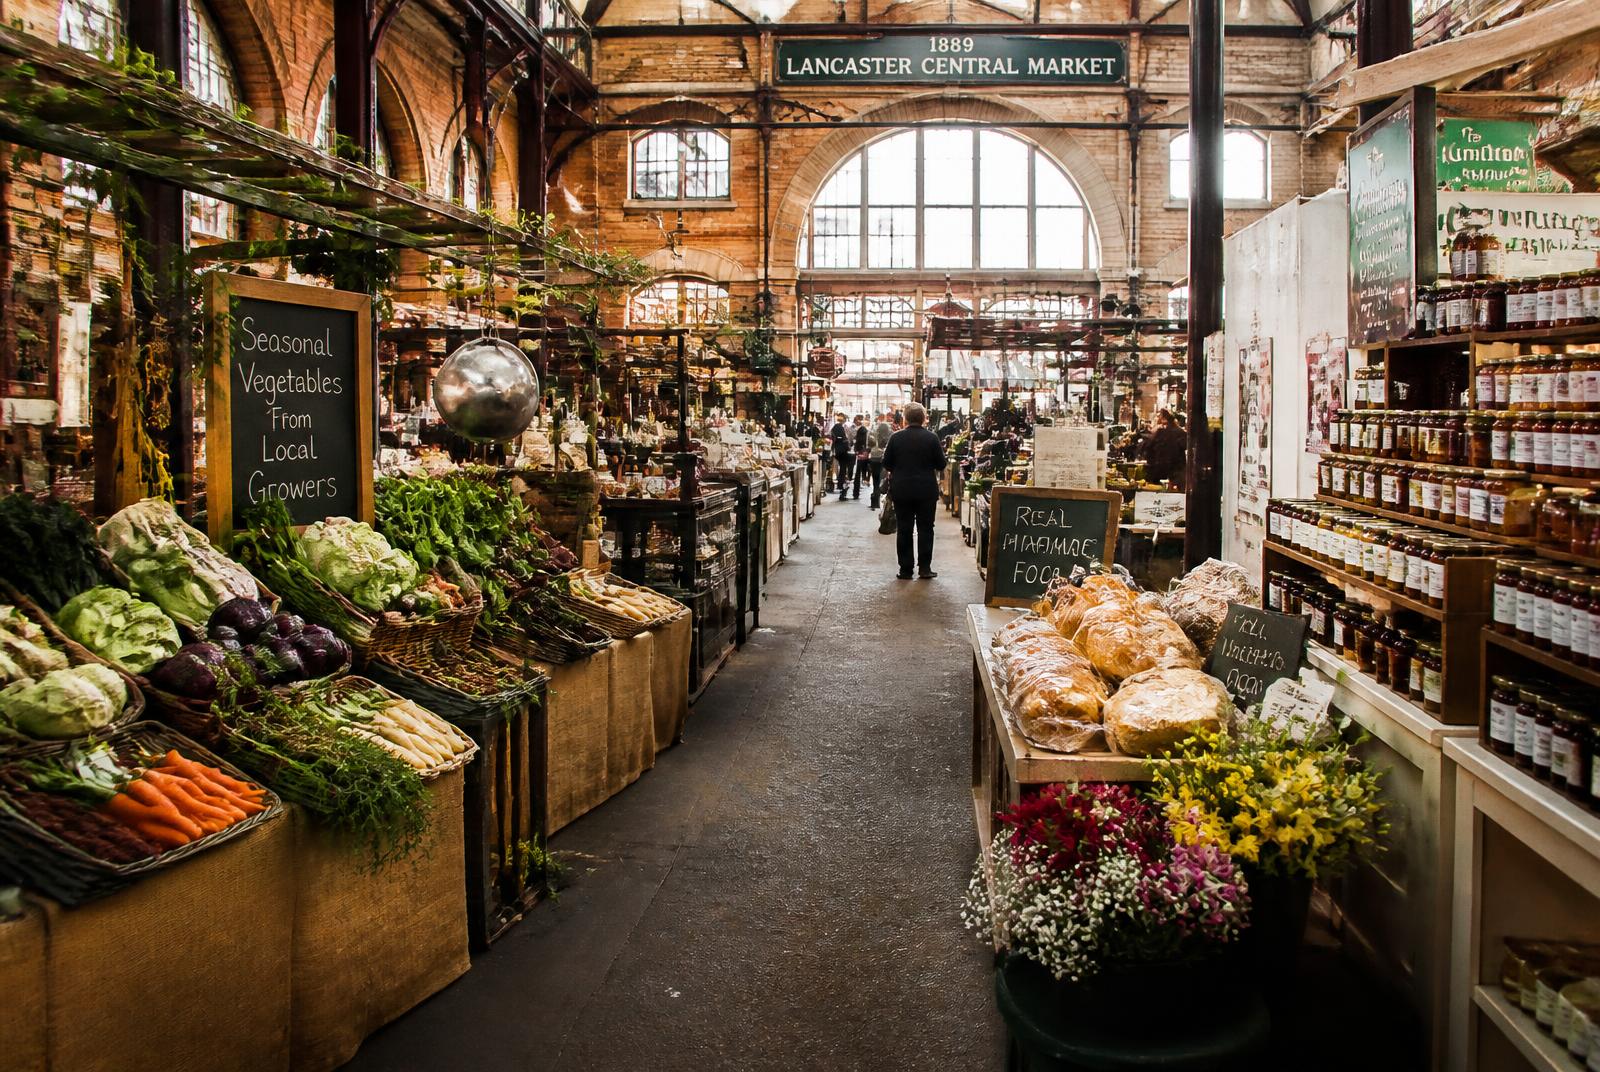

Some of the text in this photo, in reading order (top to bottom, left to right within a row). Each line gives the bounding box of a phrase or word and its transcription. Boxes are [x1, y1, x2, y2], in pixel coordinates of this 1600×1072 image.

[928, 37, 974, 53] 1889
[786, 57, 1116, 75] LANCASTER CENTRAL MARKET
[240, 316, 333, 357] Seasonal
[238, 361, 343, 406] Vegetables
[269, 406, 312, 431] From
[263, 434, 318, 462] Local
[249, 470, 337, 504] Growers
[1015, 506, 1073, 528] REAL
